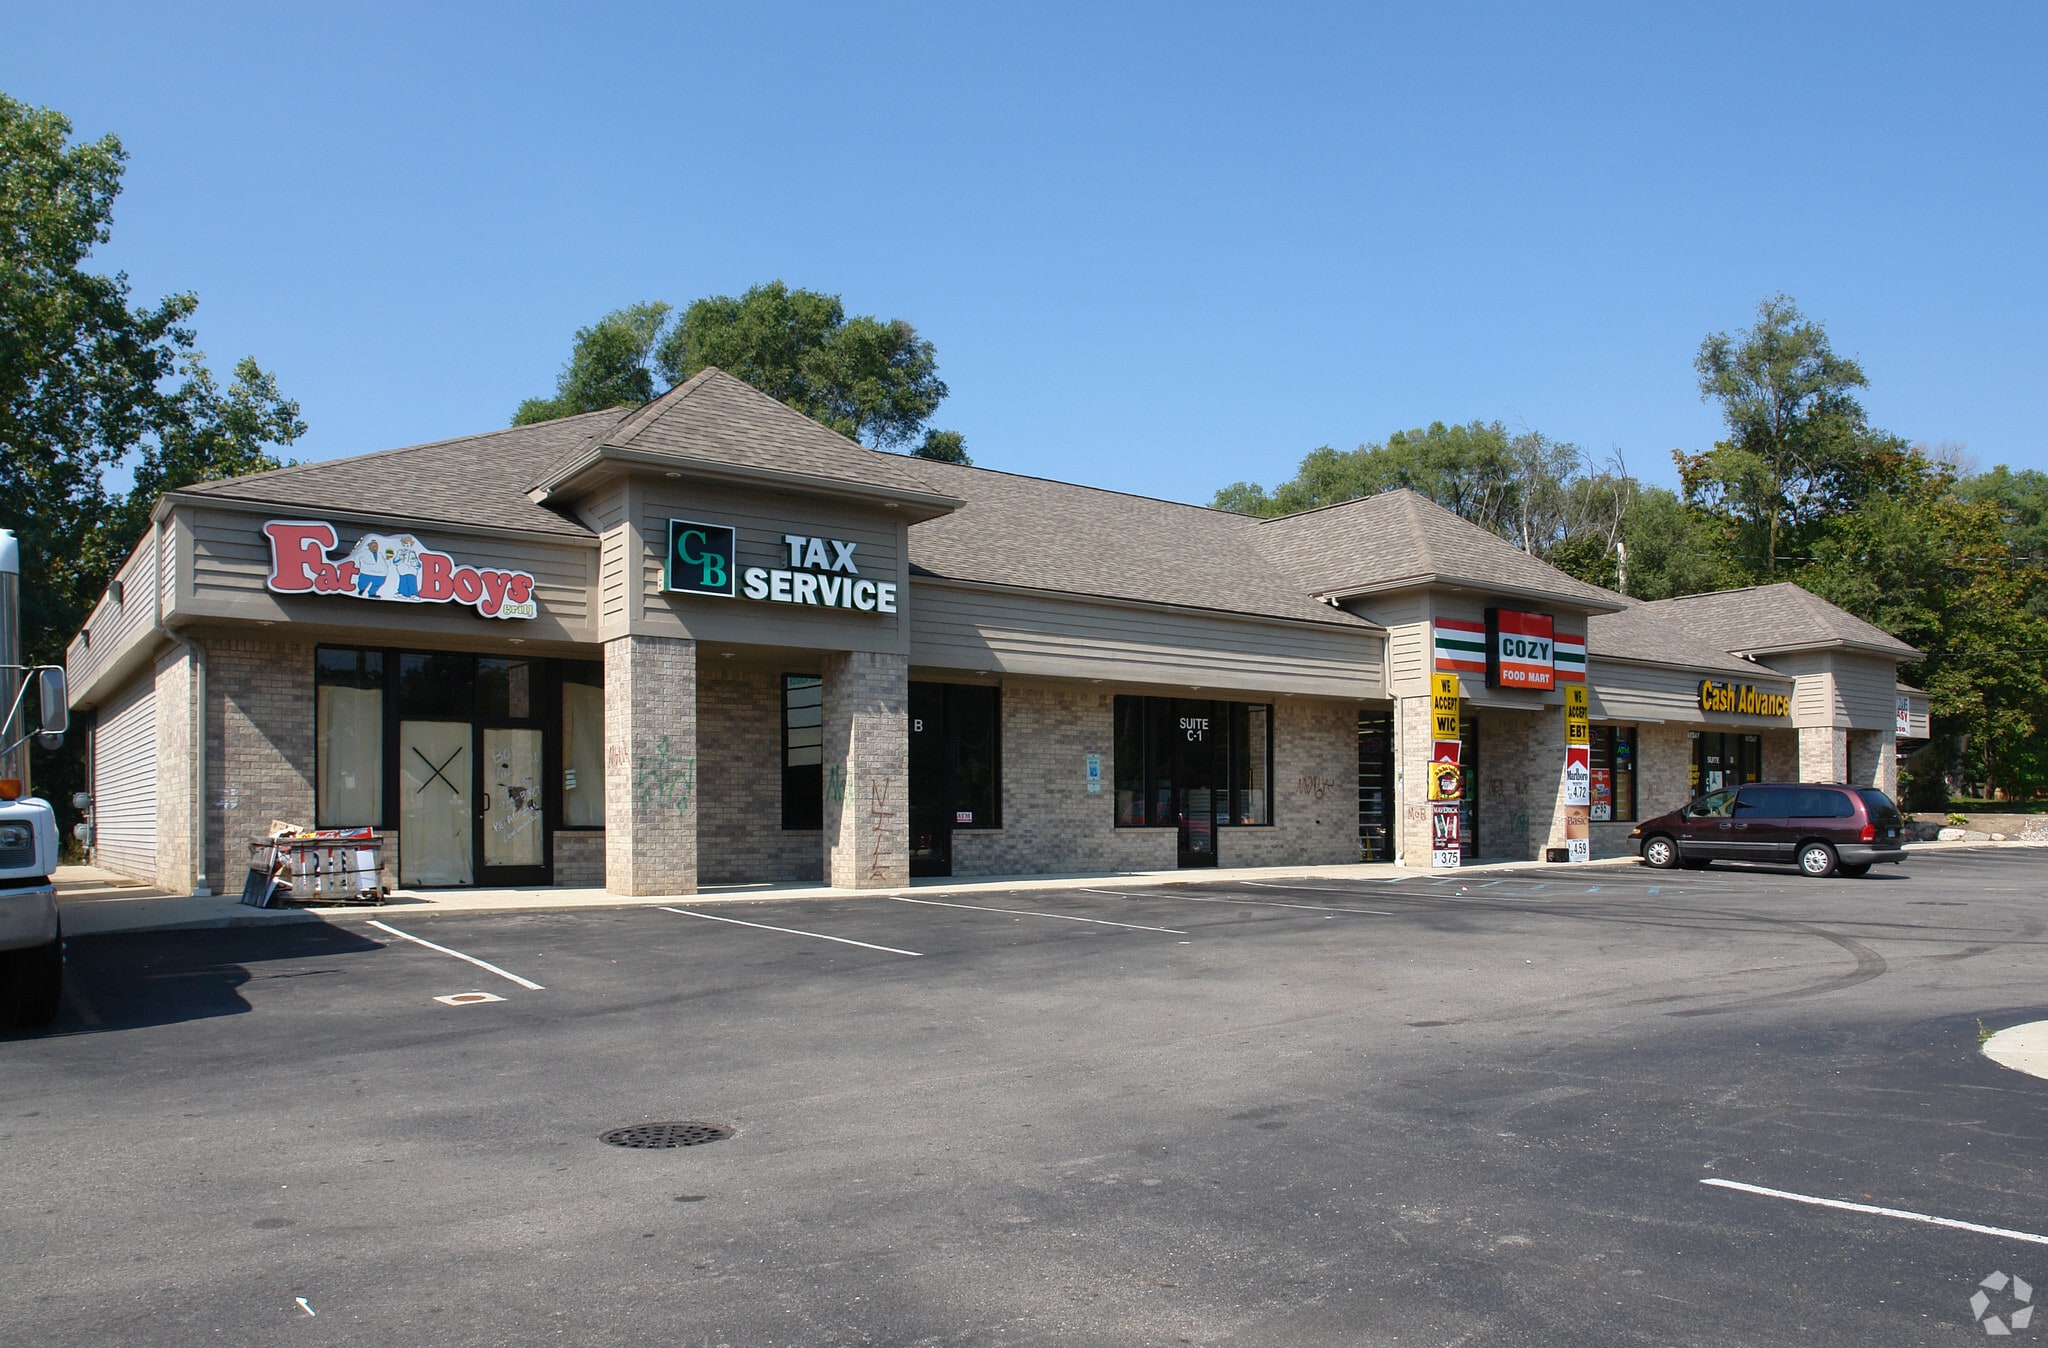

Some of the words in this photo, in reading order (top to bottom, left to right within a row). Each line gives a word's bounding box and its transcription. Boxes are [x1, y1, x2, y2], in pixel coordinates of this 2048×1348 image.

[783, 535, 859, 573] TAX
[266, 524, 360, 592] Fat
[418, 553, 534, 614] Boys
[743, 567, 897, 613] SERVICE
[503, 604, 534, 615] grill
[1503, 638, 1549, 660] COZY
[1503, 669, 1525, 681] FOOD
[1528, 672, 1550, 683] MART
[1441, 679, 1452, 693] WE
[1435, 696, 1457, 710] ACCEPT
[1574, 690, 1582, 703] WE
[1702, 679, 1736, 712] Cash
[1738, 684, 1791, 717] Advance
[1568, 705, 1587, 718] ACCEPT
[914, 719, 923, 732] B
[1179, 717, 1209, 730] SUITE
[1437, 717, 1456, 731] WIC
[1187, 730, 1202, 742] C-1
[1570, 724, 1586, 737] EBT
[1707, 756, 1720, 764] SUITE
[1567, 768, 1588, 781] Marlboro
[1567, 815, 1588, 826] Basic
